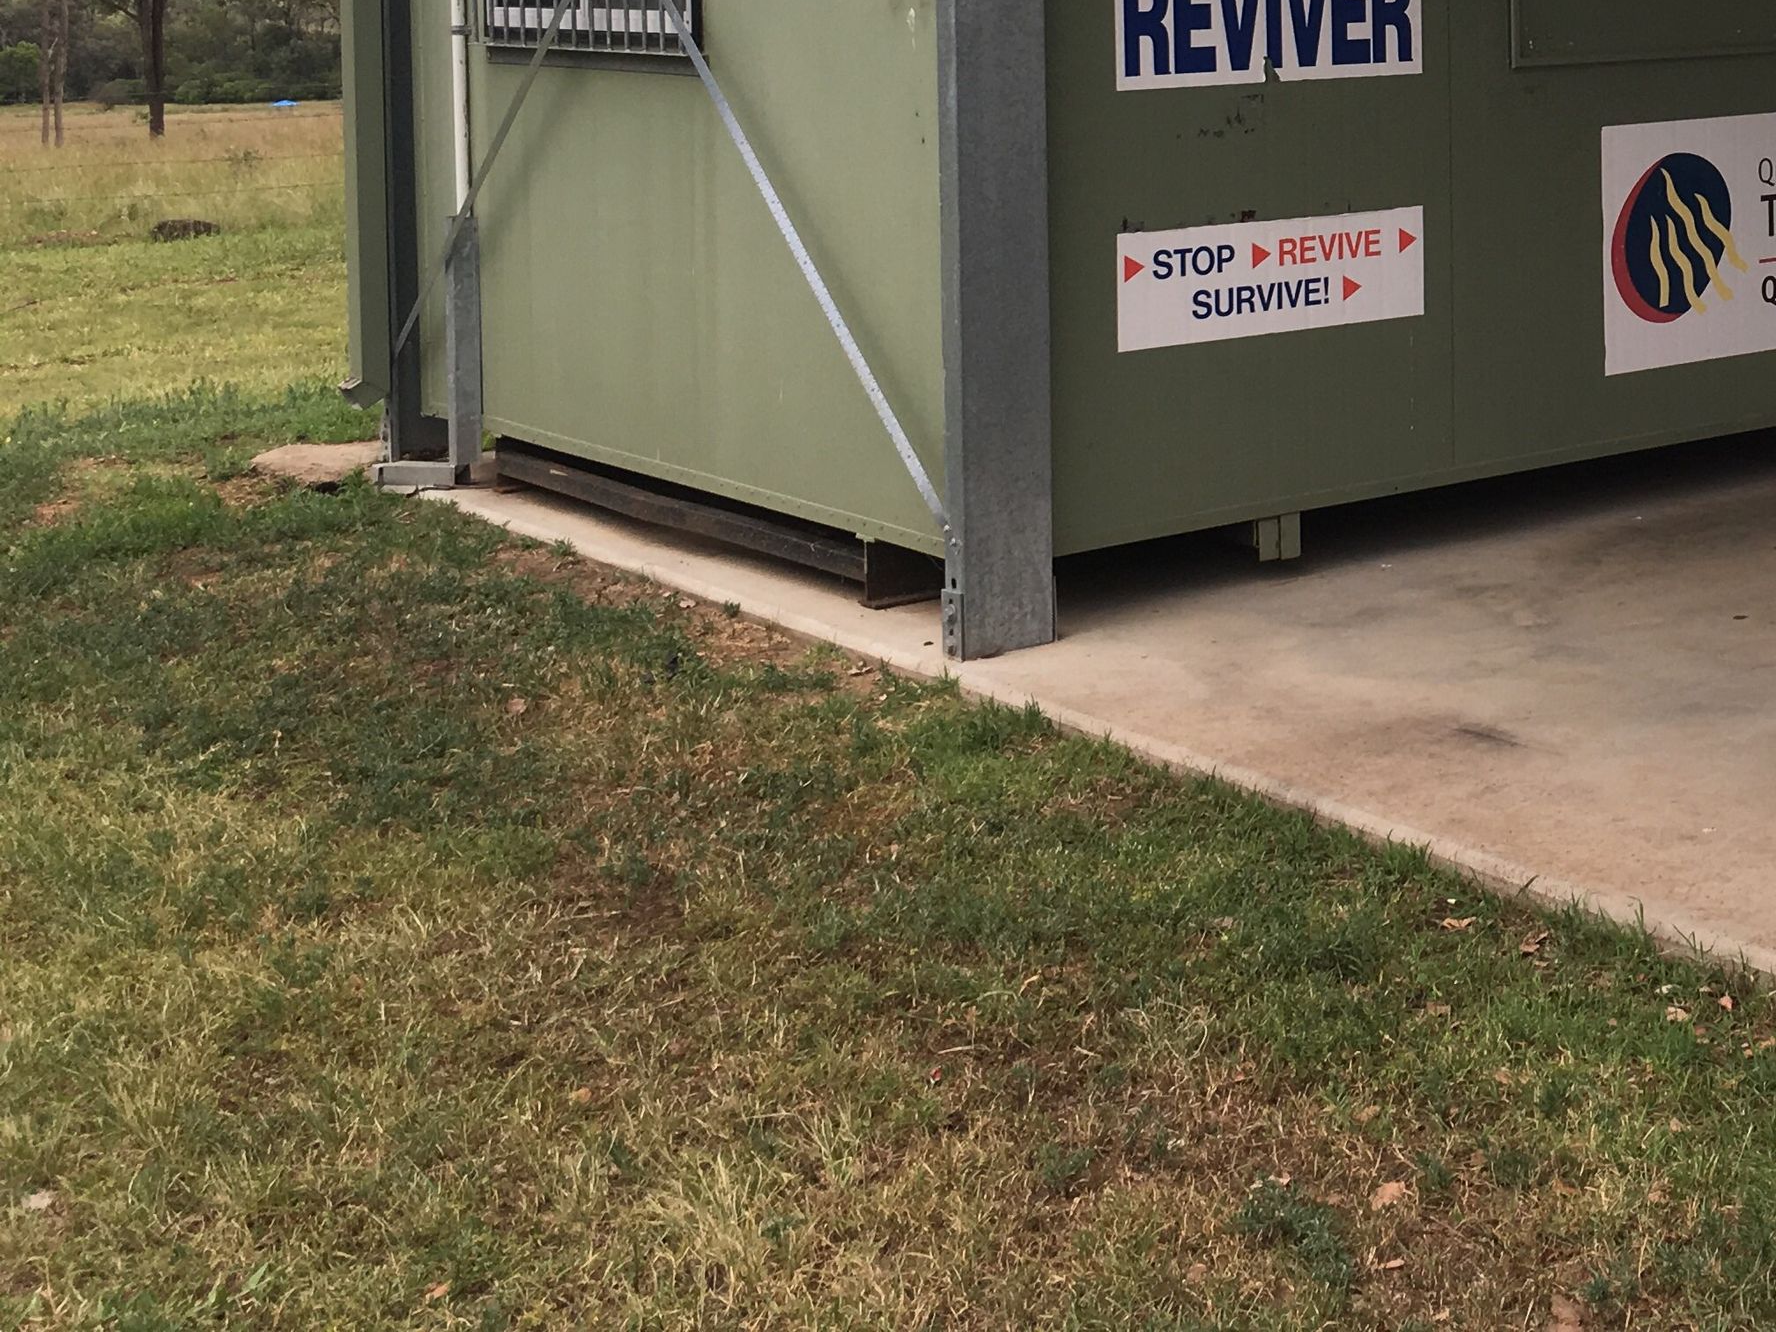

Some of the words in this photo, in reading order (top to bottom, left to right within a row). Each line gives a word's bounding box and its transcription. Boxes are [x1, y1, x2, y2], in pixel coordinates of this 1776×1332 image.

[1152, 244, 1235, 280] STOP
[1278, 229, 1382, 267] REVIVE
[1192, 276, 1329, 320] SURVIVE!
